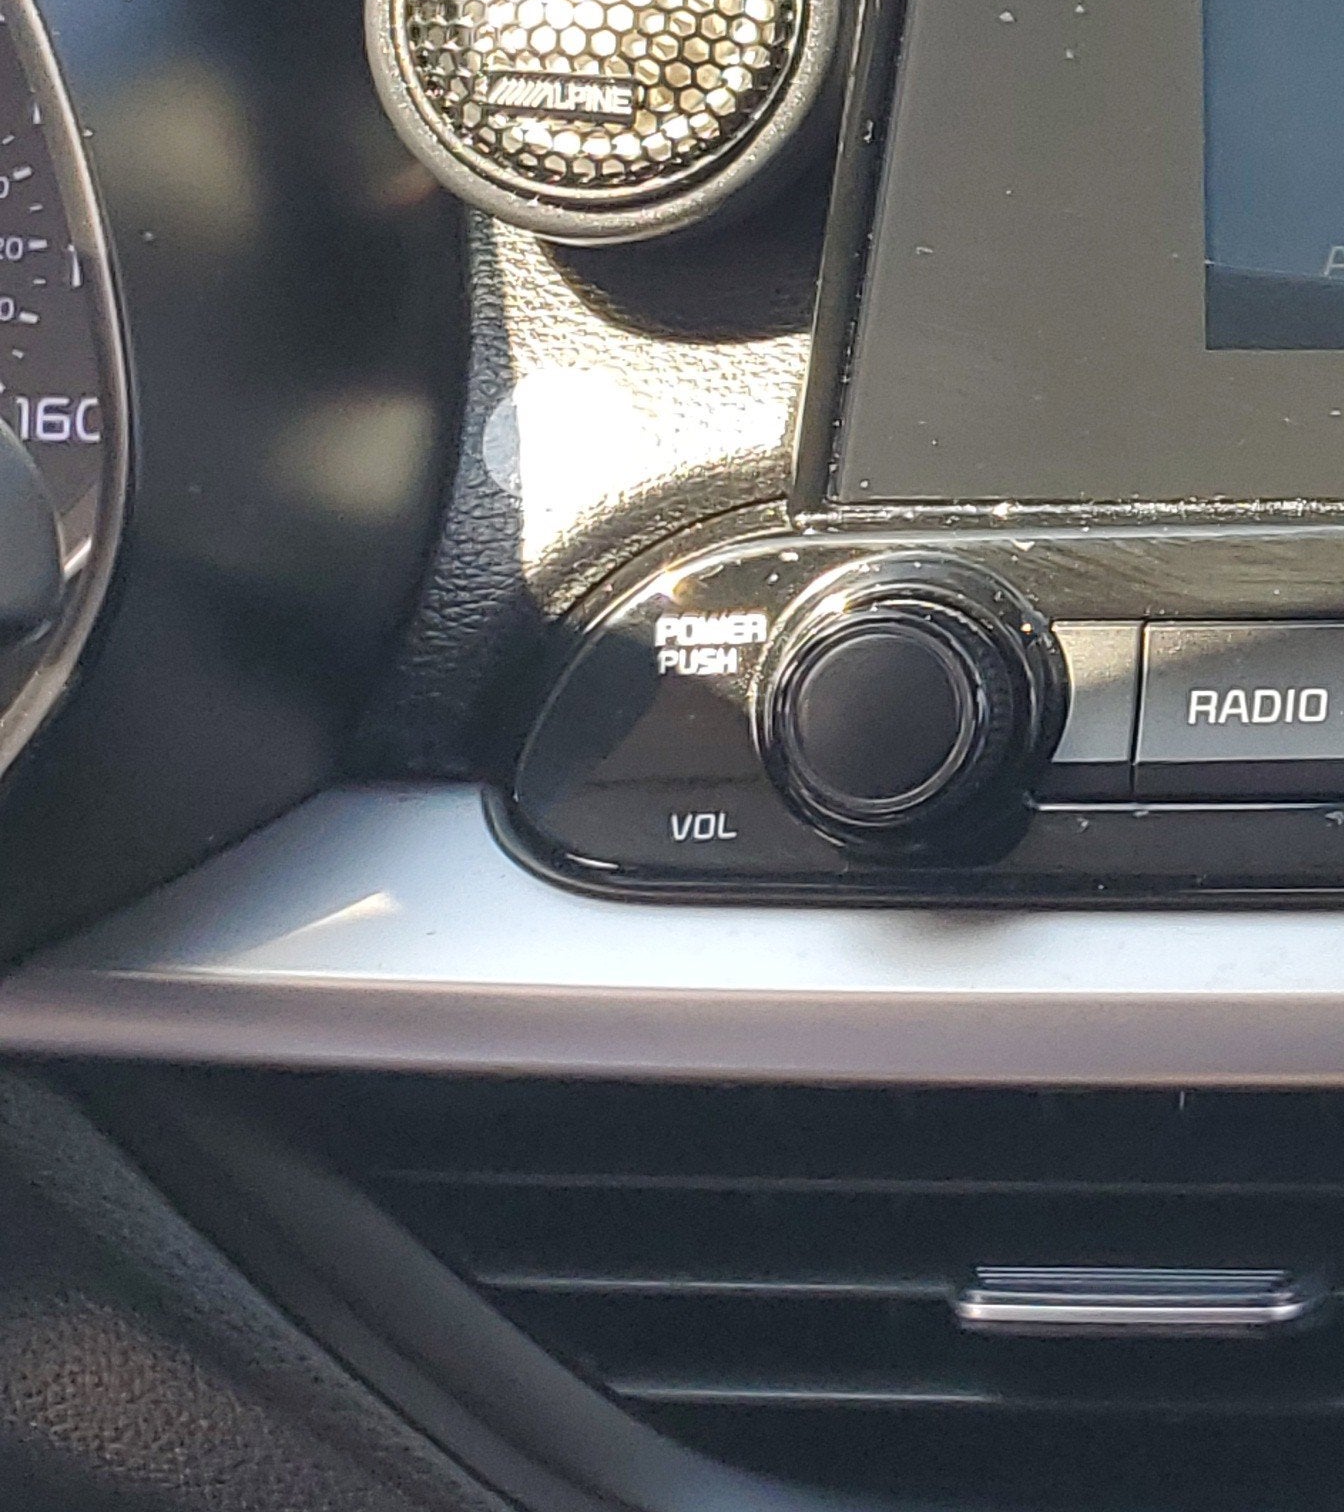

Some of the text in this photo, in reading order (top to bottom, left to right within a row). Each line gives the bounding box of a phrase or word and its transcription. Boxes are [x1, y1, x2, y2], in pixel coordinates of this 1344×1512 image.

[530, 80, 632, 115] ALPINE
[656, 646, 739, 675] PUSH
[1187, 688, 1330, 725] RADIO
[670, 813, 737, 842] VOL
